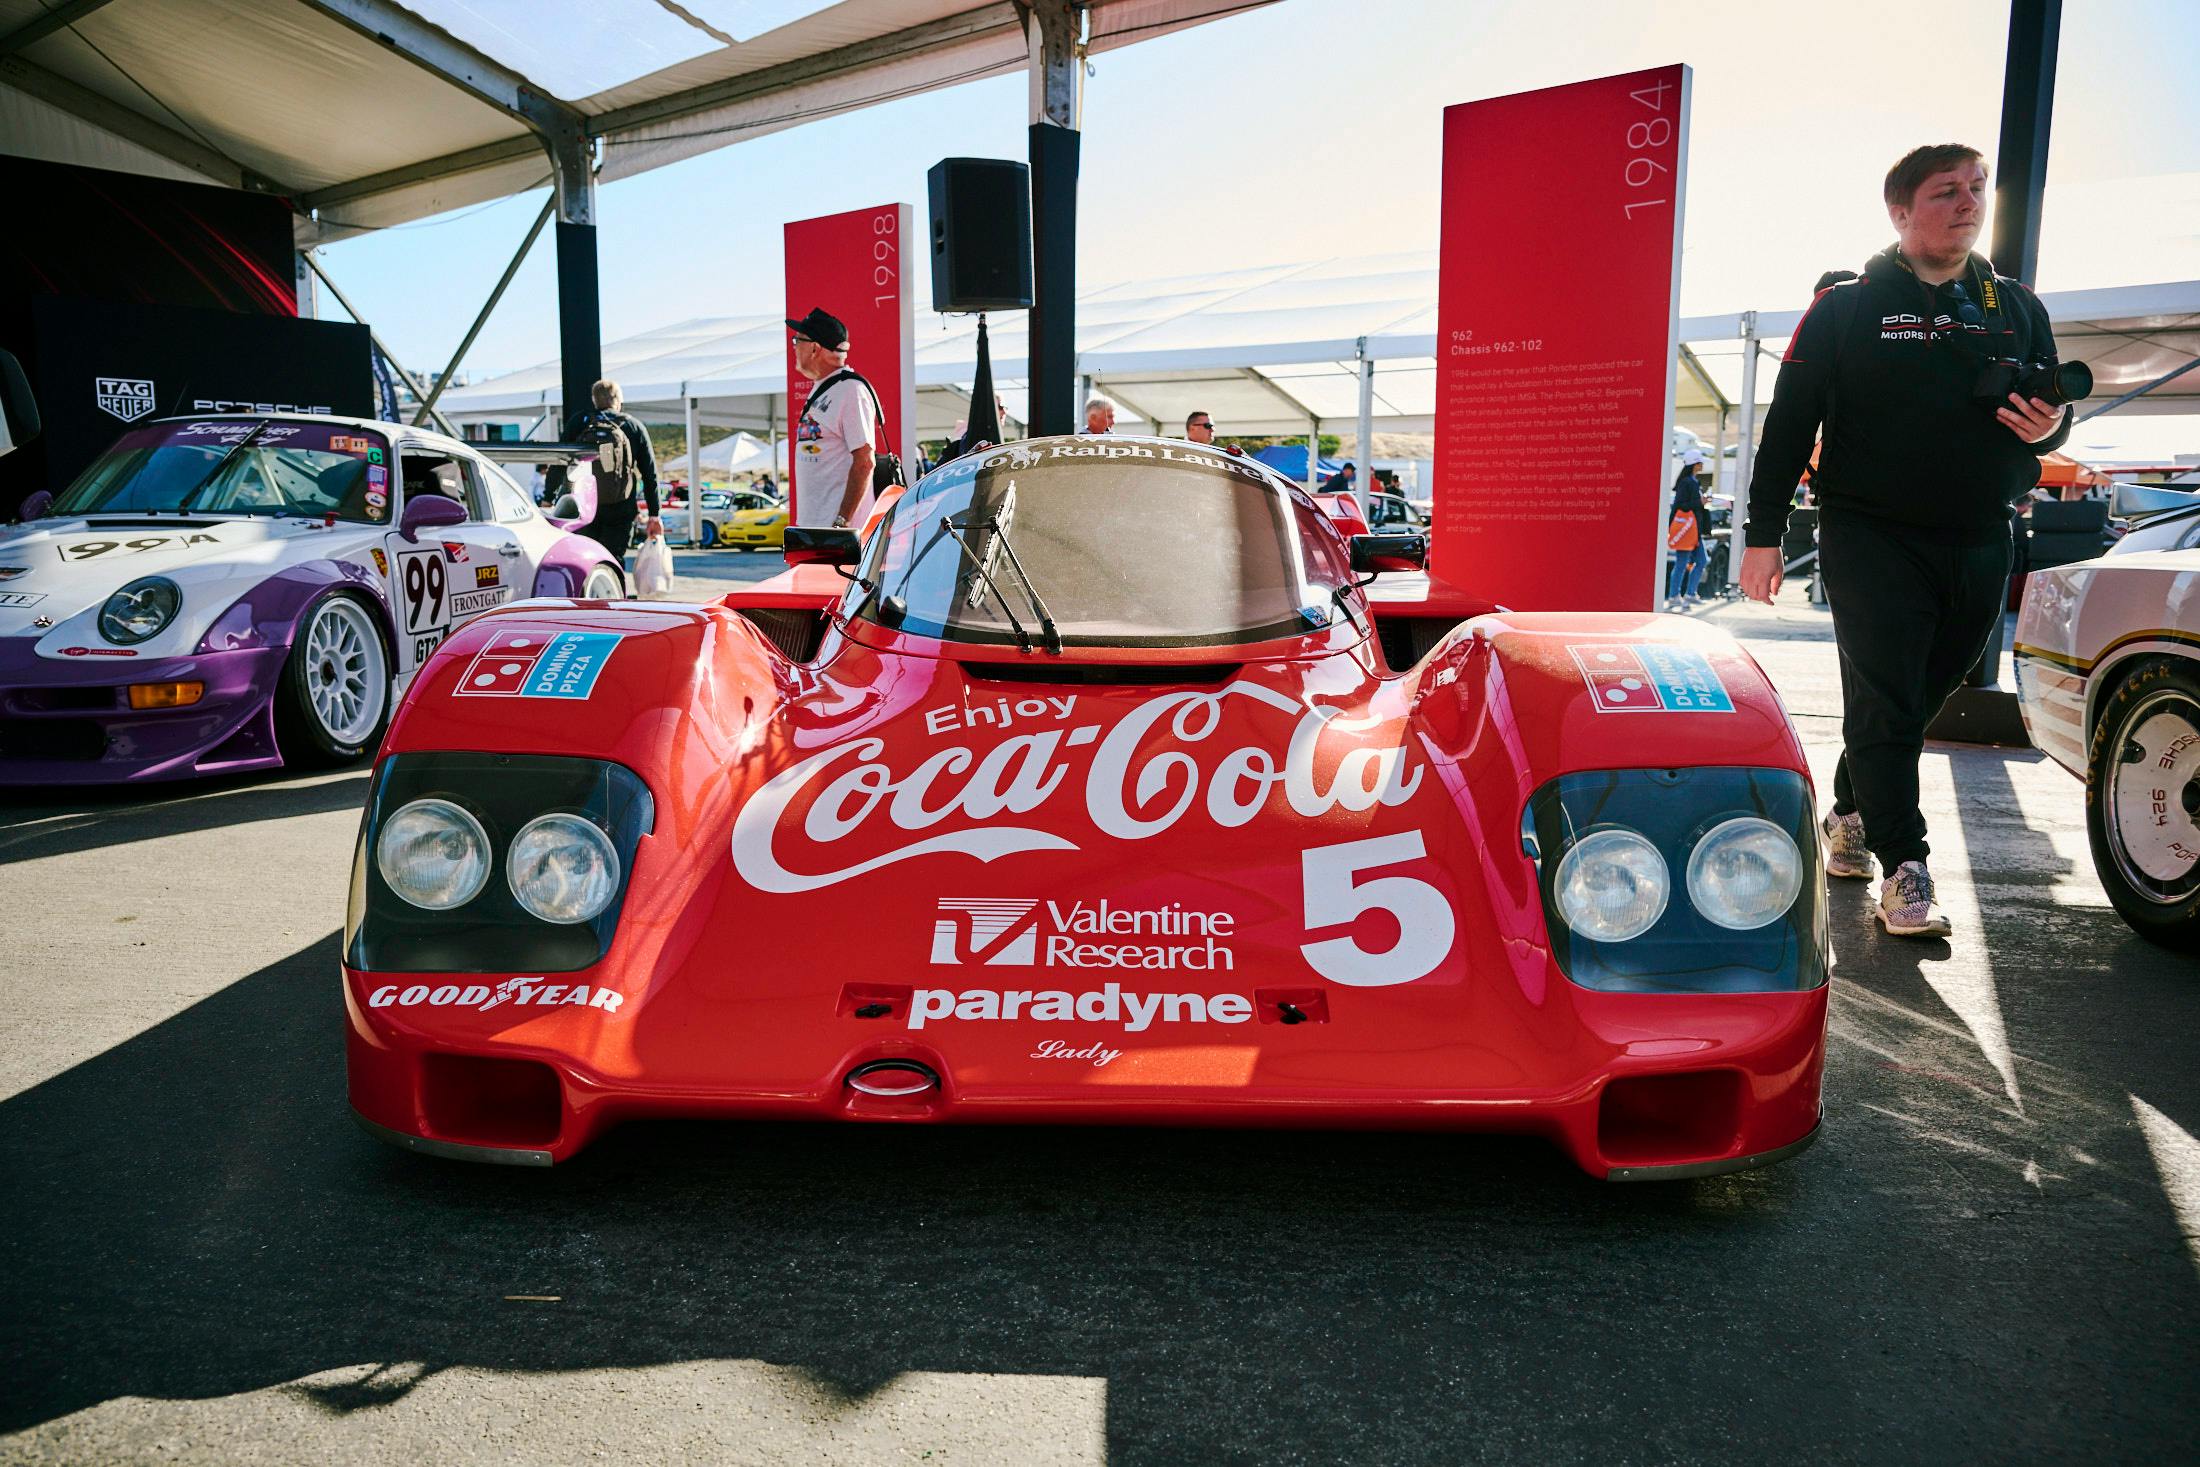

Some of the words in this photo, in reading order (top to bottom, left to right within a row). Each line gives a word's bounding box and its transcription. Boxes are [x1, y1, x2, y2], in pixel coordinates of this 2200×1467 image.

[1624, 80, 1672, 220] 1984
[874, 214, 896, 309] 1998
[1983, 280, 1997, 308] Nikon
[1451, 345, 1490, 355] Chassis
[1493, 340, 1542, 352] 962-102
[1452, 330, 1472, 341] 962
[1548, 362, 1578, 372] Porsche
[1579, 360, 1615, 372] produced
[1572, 374, 1615, 384] dominance
[101, 381, 149, 395] TAG
[1605, 387, 1644, 398] Beginning
[101, 397, 151, 418] HEUER
[1548, 403, 1577, 413] Porsche
[1602, 416, 1628, 424] behind
[1570, 430, 1607, 440] extending
[1575, 444, 1601, 453] behind
[934, 456, 1007, 485] Polo
[1050, 445, 1155, 459] Ralph
[1572, 472, 1606, 480] delivered
[1607, 472, 1624, 480] with
[1595, 485, 1622, 495] engine
[1563, 512, 1606, 523] horsepower
[68, 538, 169, 560] 99
[190, 534, 220, 543] A
[477, 566, 498, 580] JRZ
[406, 554, 445, 630] 99
[536, 634, 585, 693] DOMINO'S
[559, 655, 593, 693] PIZZA
[925, 694, 1078, 736] Enjoy
[732, 680, 1424, 893] Coca-Cola
[2152, 788, 2168, 827] 924
[1046, 898, 1234, 937] Valentine
[1300, 829, 1455, 986] 5
[1046, 936, 1234, 970] Research
[908, 983, 1252, 1031] paradyne
[1030, 1039, 1122, 1067] Lady
